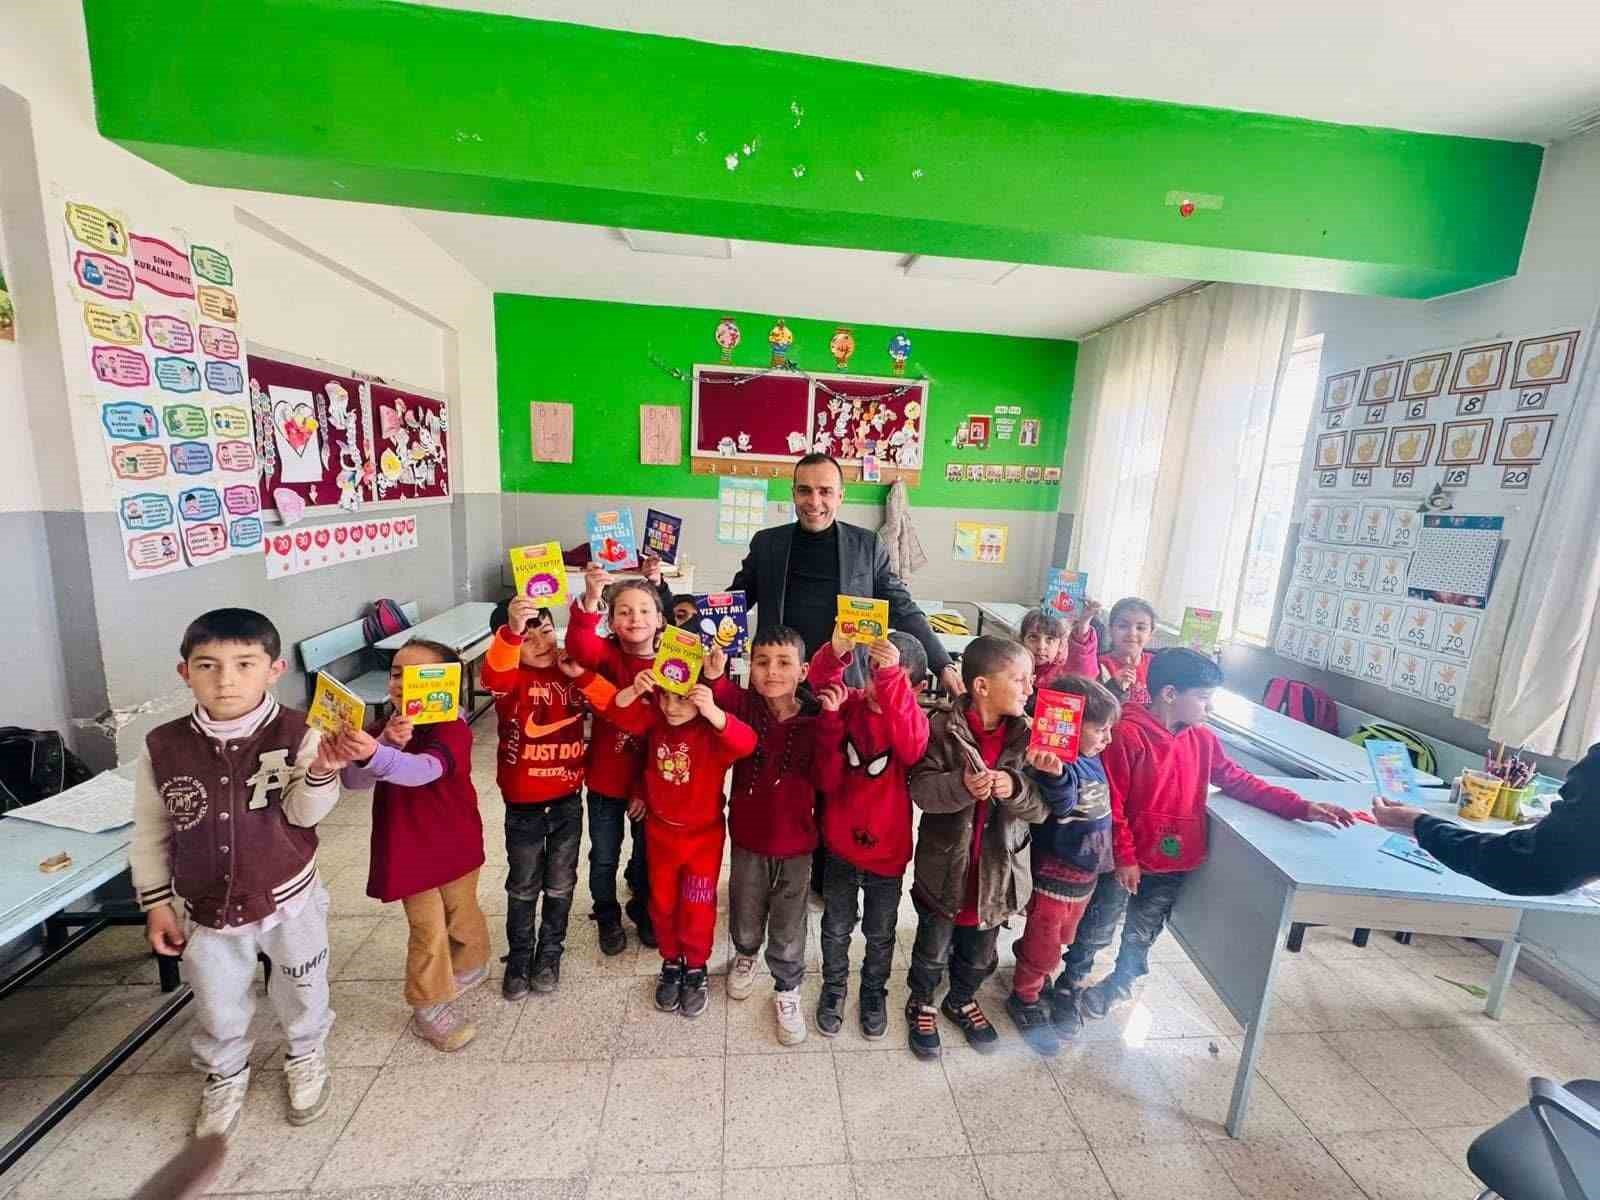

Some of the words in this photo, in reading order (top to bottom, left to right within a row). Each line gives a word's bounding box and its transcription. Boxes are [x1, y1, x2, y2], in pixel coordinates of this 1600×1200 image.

[153, 255, 172, 267] SINIF
[134, 259, 191, 284] KURALLARIMIZ
[1332, 415, 1342, 426] 2
[1372, 407, 1382, 418] 4
[1411, 403, 1423, 416] 6
[1464, 397, 1480, 411] 8
[1520, 392, 1542, 406] 10
[1323, 473, 1335, 484] 12
[1354, 472, 1368, 482] 14
[1396, 472, 1410, 483] 16
[1447, 471, 1466, 482] 18
[1503, 471, 1528, 483] 20
[1394, 528, 1410, 540] 20
[1382, 575, 1398, 587] 40
[1408, 629, 1425, 641] 65
[1446, 635, 1464, 649] 70
[1337, 655, 1351, 666] 85
[1401, 673, 1417, 686] 95
[1434, 681, 1457, 697] 100
[521, 743, 558, 761] JUST
[559, 741, 580, 760] DO
[245, 749, 290, 810] A
